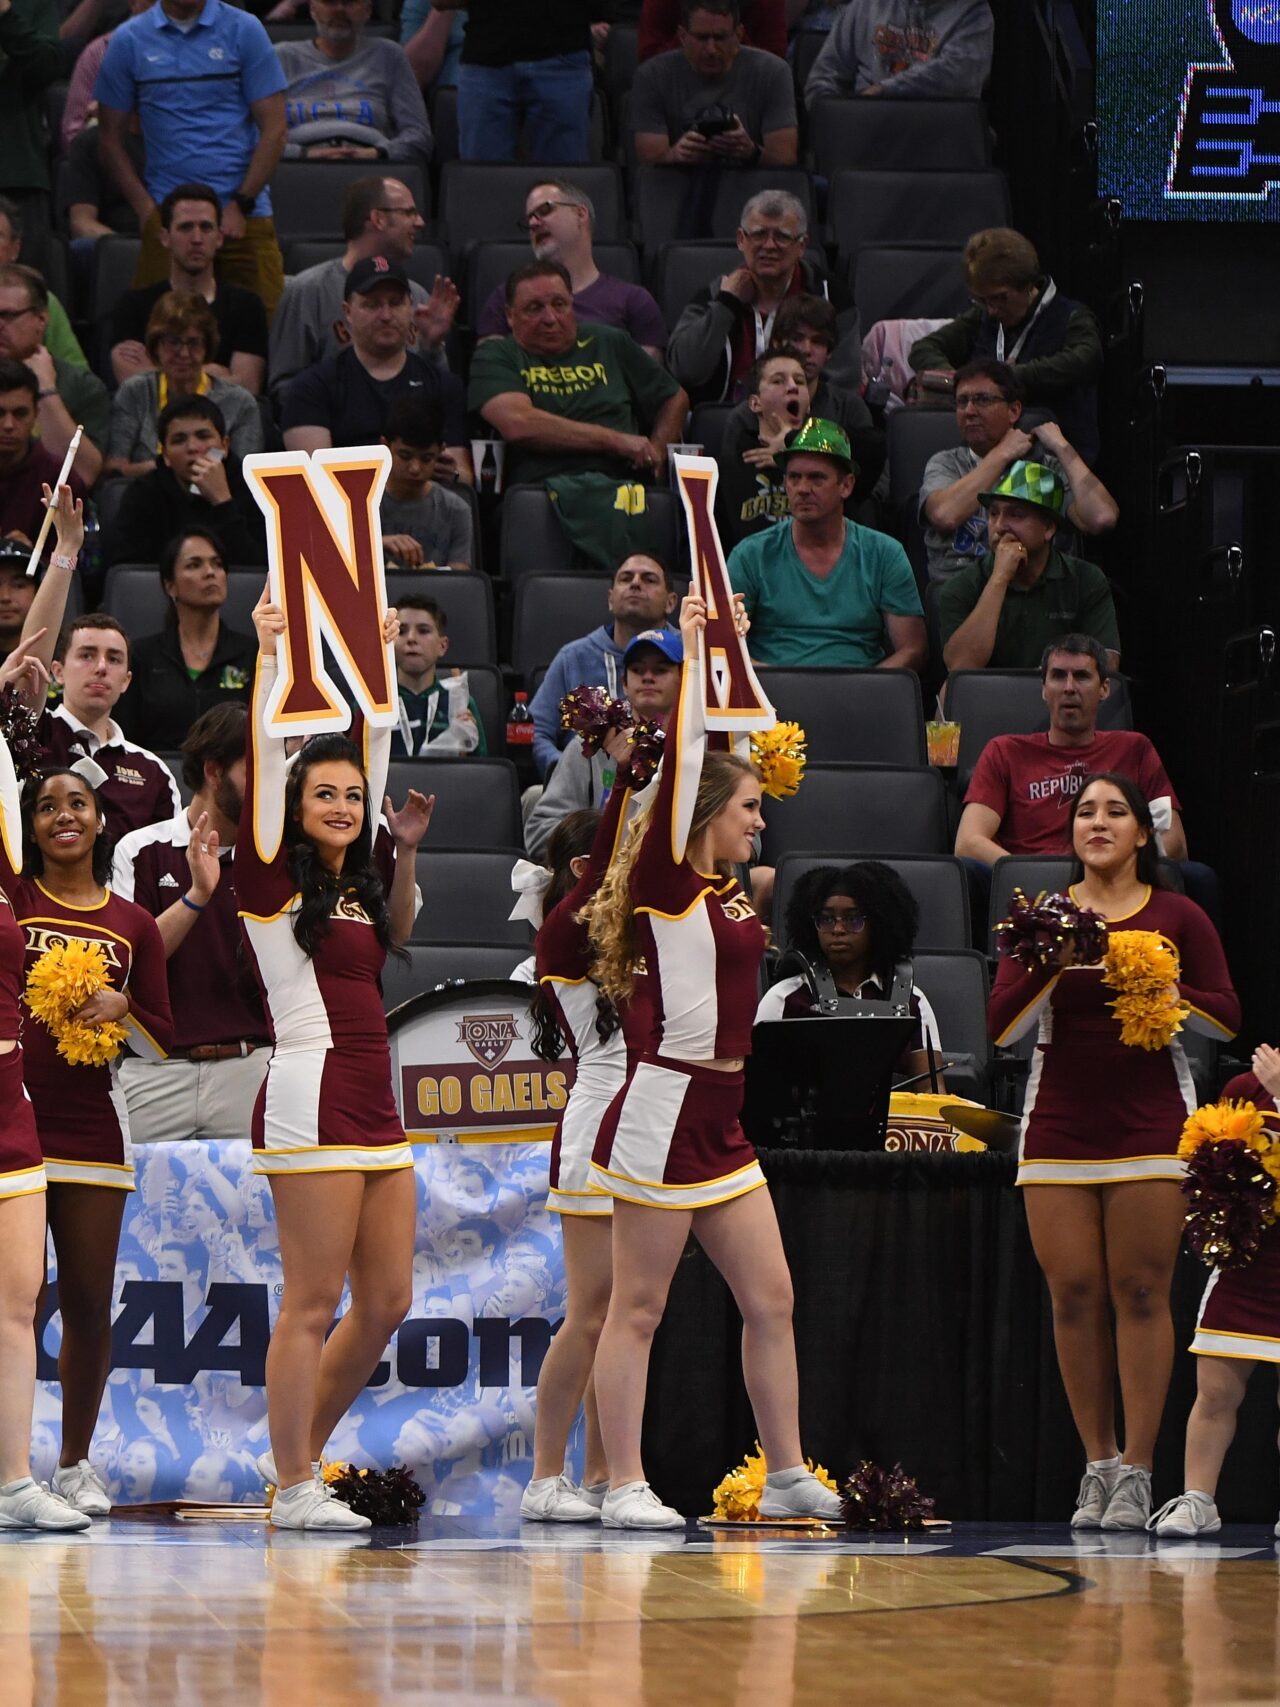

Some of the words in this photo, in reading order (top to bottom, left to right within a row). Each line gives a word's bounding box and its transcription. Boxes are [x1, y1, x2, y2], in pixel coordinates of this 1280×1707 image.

[249, 455, 394, 726] N
[1029, 775, 1084, 800] REPUB
[457, 1021, 521, 1041] IONA
[475, 1040, 504, 1048] GAELS
[417, 1076, 462, 1116] GO
[470, 1071, 568, 1113] GAELS
[886, 1129, 957, 1153] ONA
